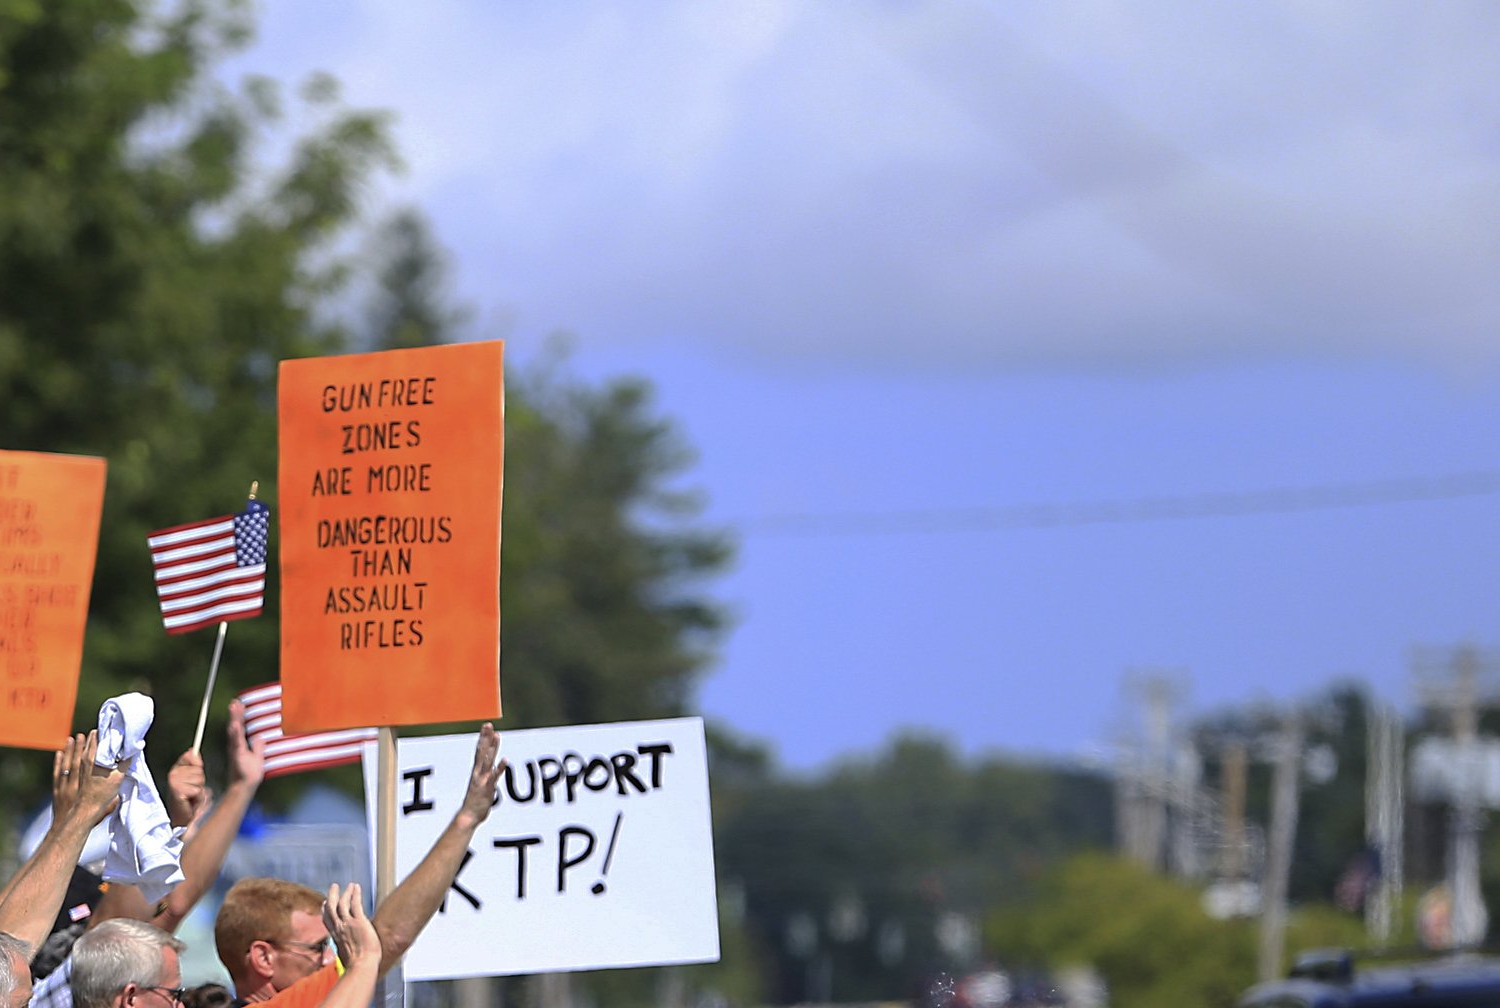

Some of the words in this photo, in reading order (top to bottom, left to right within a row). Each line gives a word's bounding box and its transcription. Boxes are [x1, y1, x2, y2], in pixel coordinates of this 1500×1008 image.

[322, 382, 373, 412] GUN
[378, 377, 436, 407] FREE
[341, 421, 421, 454] ZONES
[312, 467, 352, 496] ARE
[367, 463, 432, 494] MORE
[317, 515, 453, 548] DANGEROUS
[351, 548, 411, 577] THAN
[324, 583, 428, 614] ASSAULT
[341, 619, 424, 650] RIFLES
[403, 769, 434, 815] I
[490, 744, 673, 806] UPPORT
